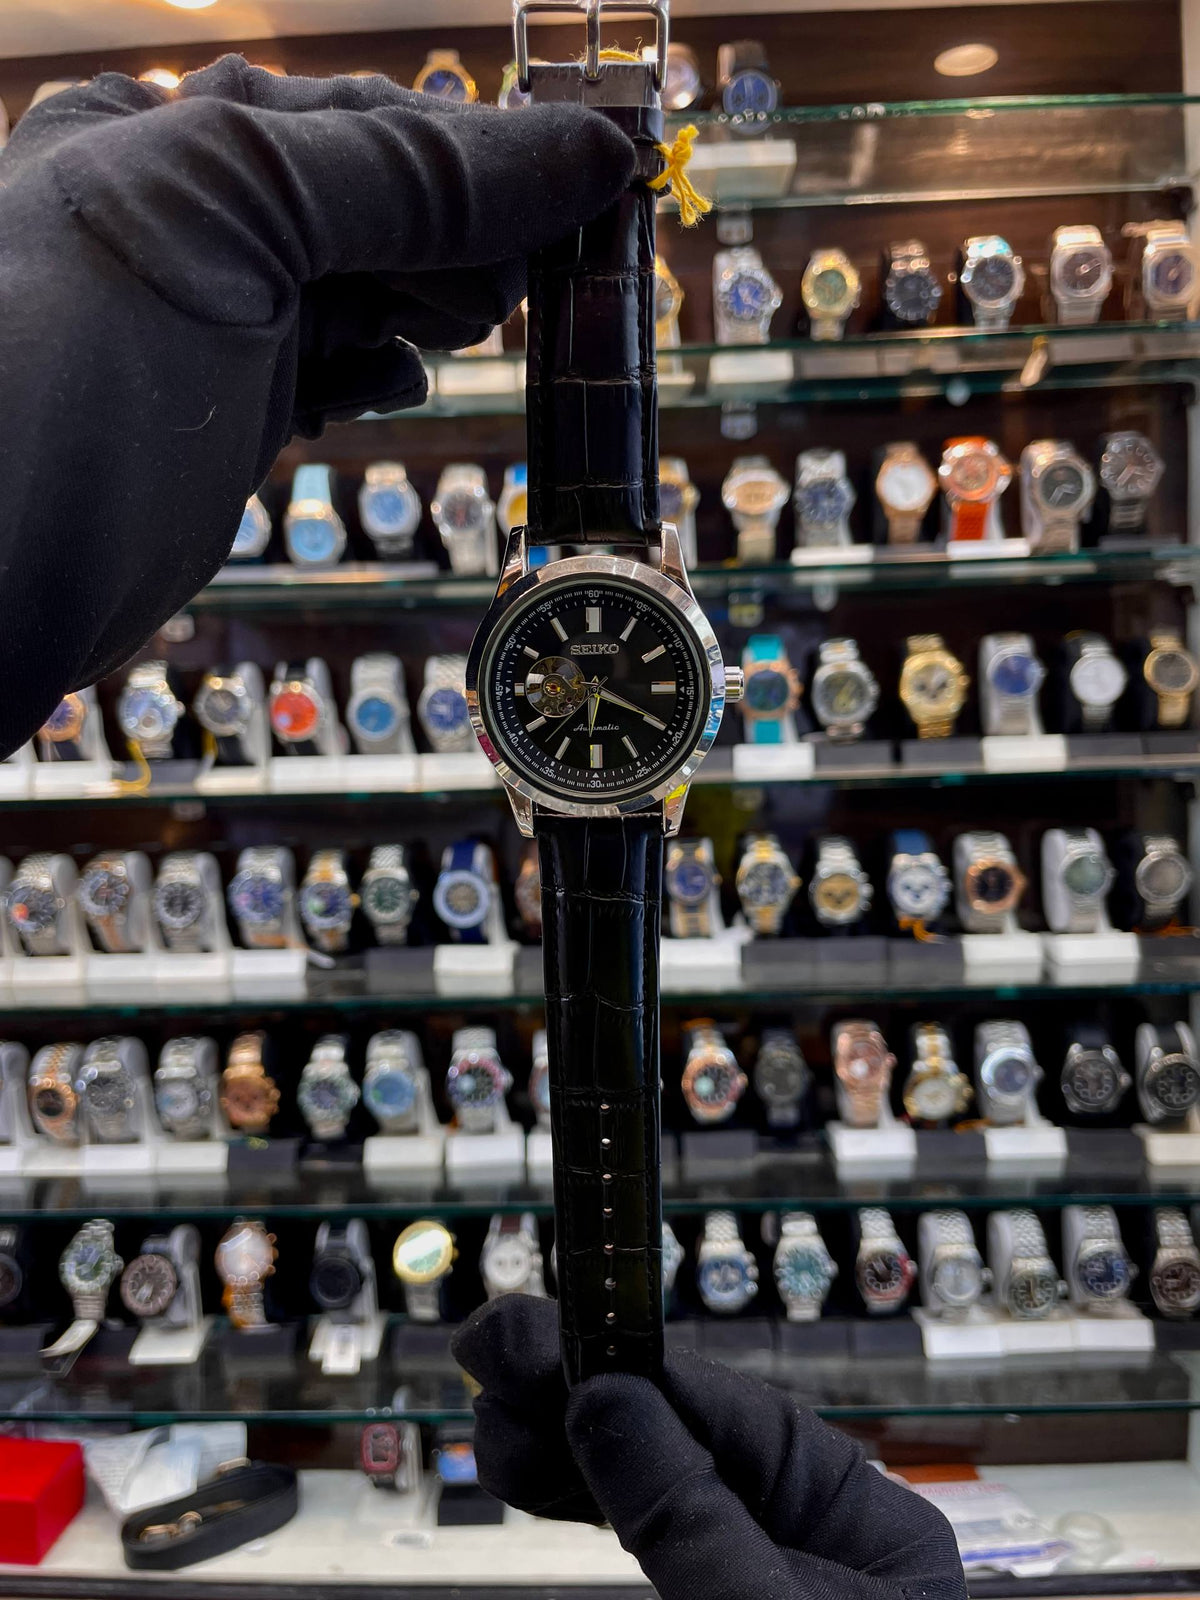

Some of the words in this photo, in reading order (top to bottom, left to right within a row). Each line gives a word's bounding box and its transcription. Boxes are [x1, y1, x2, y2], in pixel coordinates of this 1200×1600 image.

[588, 590, 600, 598] 60
[540, 602, 551, 613] 55
[636, 601, 648, 612] 05
[506, 637, 517, 649] 50
[673, 637, 683, 648] 10
[570, 644, 619, 655] SEIKO
[495, 685, 504, 696] 45
[686, 686, 695, 696] 15
[573, 723, 620, 732] Auomatic
[508, 732, 519, 745] 40
[672, 731, 682, 744] 20
[543, 766, 554, 777] 35
[637, 766, 648, 777] 25
[590, 780, 601, 788] 30
